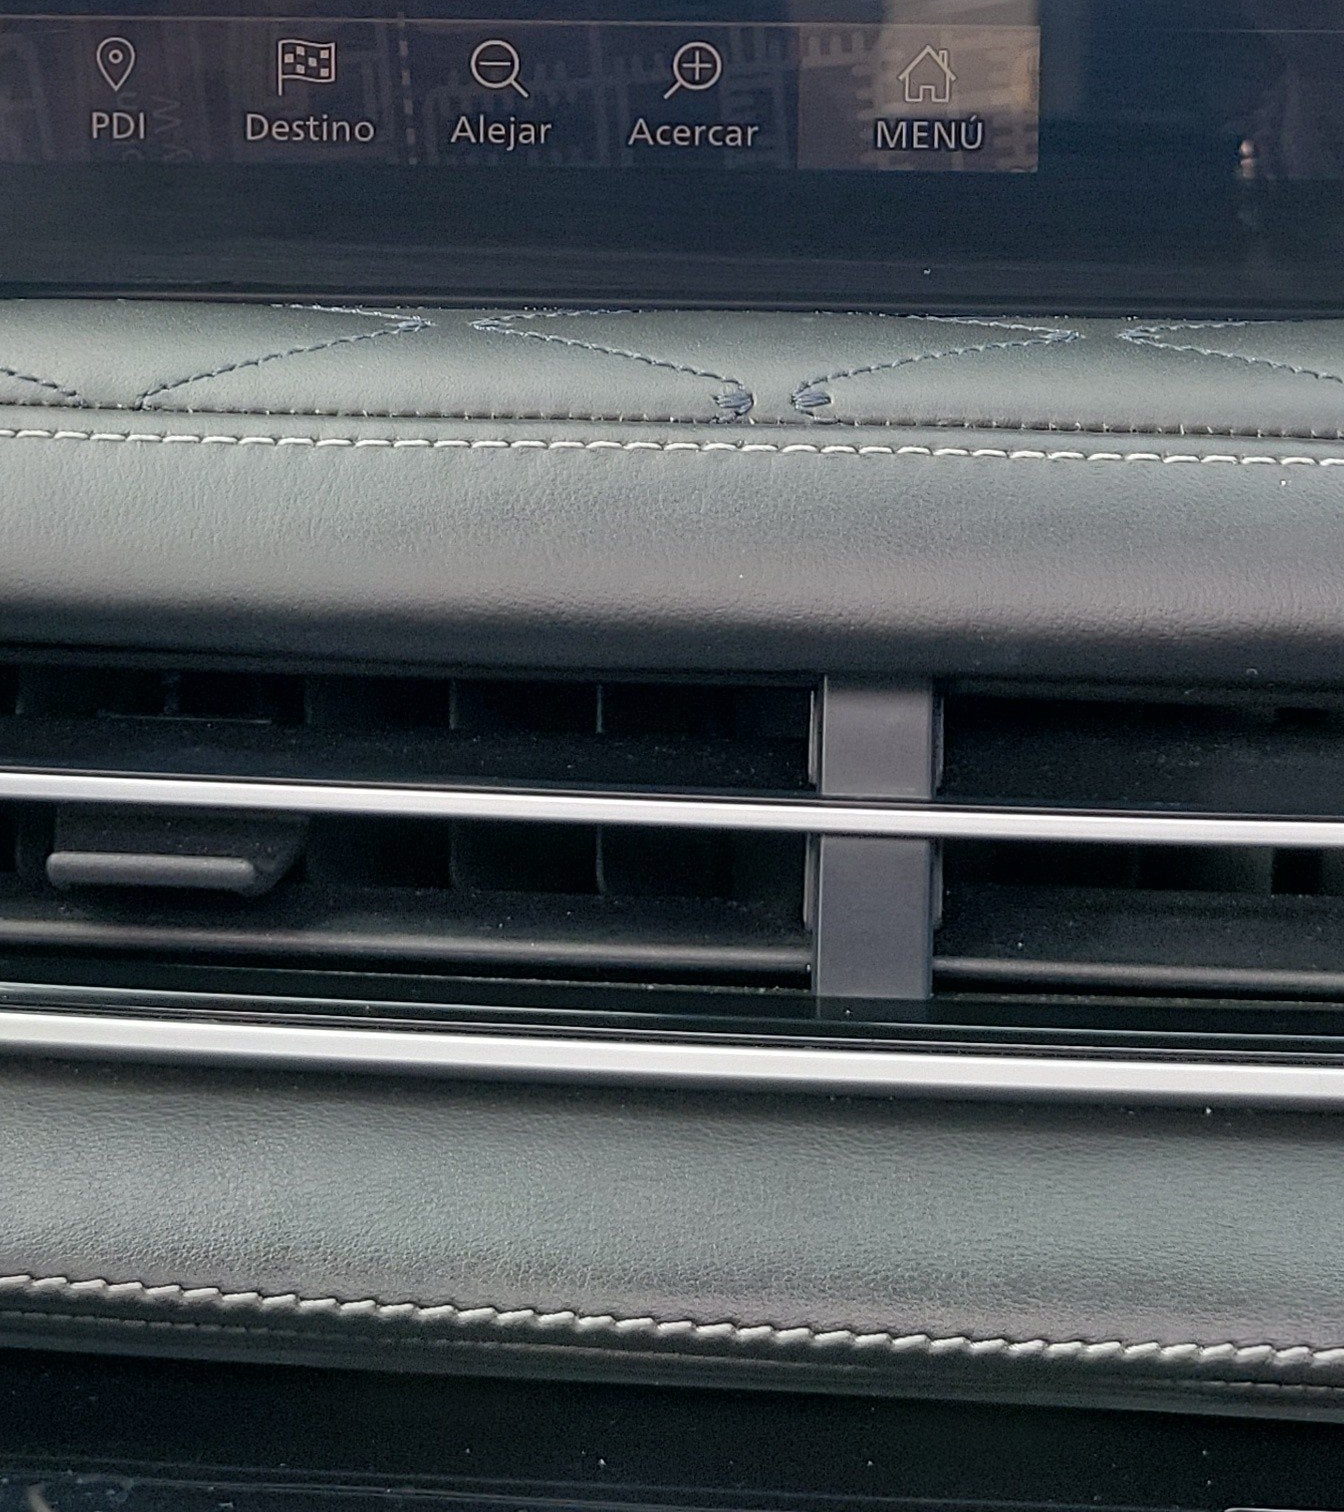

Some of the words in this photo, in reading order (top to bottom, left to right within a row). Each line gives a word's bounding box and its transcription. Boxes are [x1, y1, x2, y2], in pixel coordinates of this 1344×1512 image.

[91, 112, 147, 140] PDI
[246, 113, 375, 144] Destino
[450, 116, 552, 152] Alejar
[628, 118, 759, 147] Acercar
[874, 114, 984, 151] MENÚ
